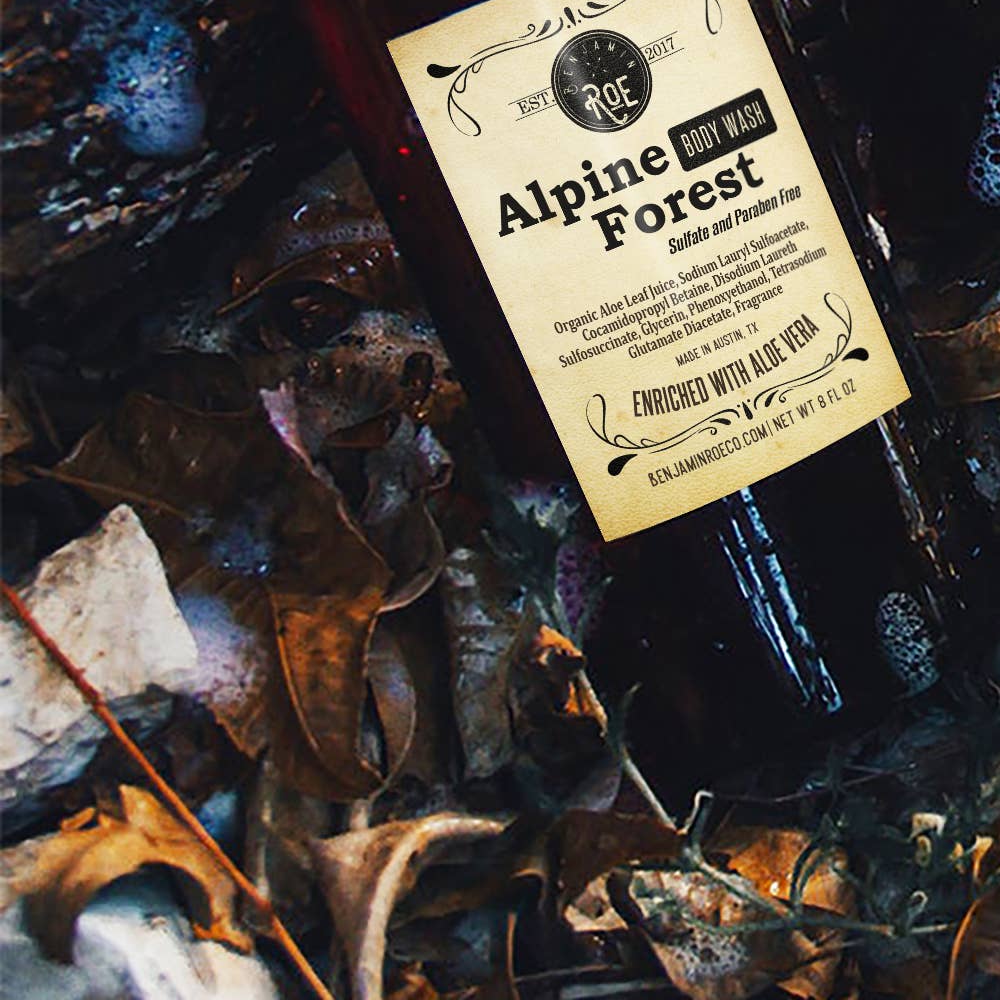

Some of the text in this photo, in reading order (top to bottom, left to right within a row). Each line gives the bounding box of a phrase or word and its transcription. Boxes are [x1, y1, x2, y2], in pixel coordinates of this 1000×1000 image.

[645, 37, 676, 60] 2017
[680, 99, 766, 159] BODY WASH
[497, 144, 669, 237] Alpine
[591, 151, 764, 252] Forest
[669, 185, 801, 254] Sulfate and Paraben Free
[554, 220, 809, 334] Organic Aloe Leaf Juice, Sodium Lauryl Sulfoacetate,
[559, 247, 827, 368] Sulfosuccinate, Glycerin, Phenoxyethanol, Tetrasodium
[582, 240, 798, 341] Cocamidopropyl Betaine, Disodium Laureth
[628, 284, 783, 358] Glutamate Diacetate, Fragrance
[675, 322, 759, 367] MADE IN AUSTIN, TX
[633, 314, 820, 417] ENRICHED WITH ALOE VERA
[772, 410, 795, 431] NET
[796, 400, 815, 419] WT
[818, 395, 826, 408] 8
[827, 388, 841, 404] FL
[841, 378, 856, 395] OZ
